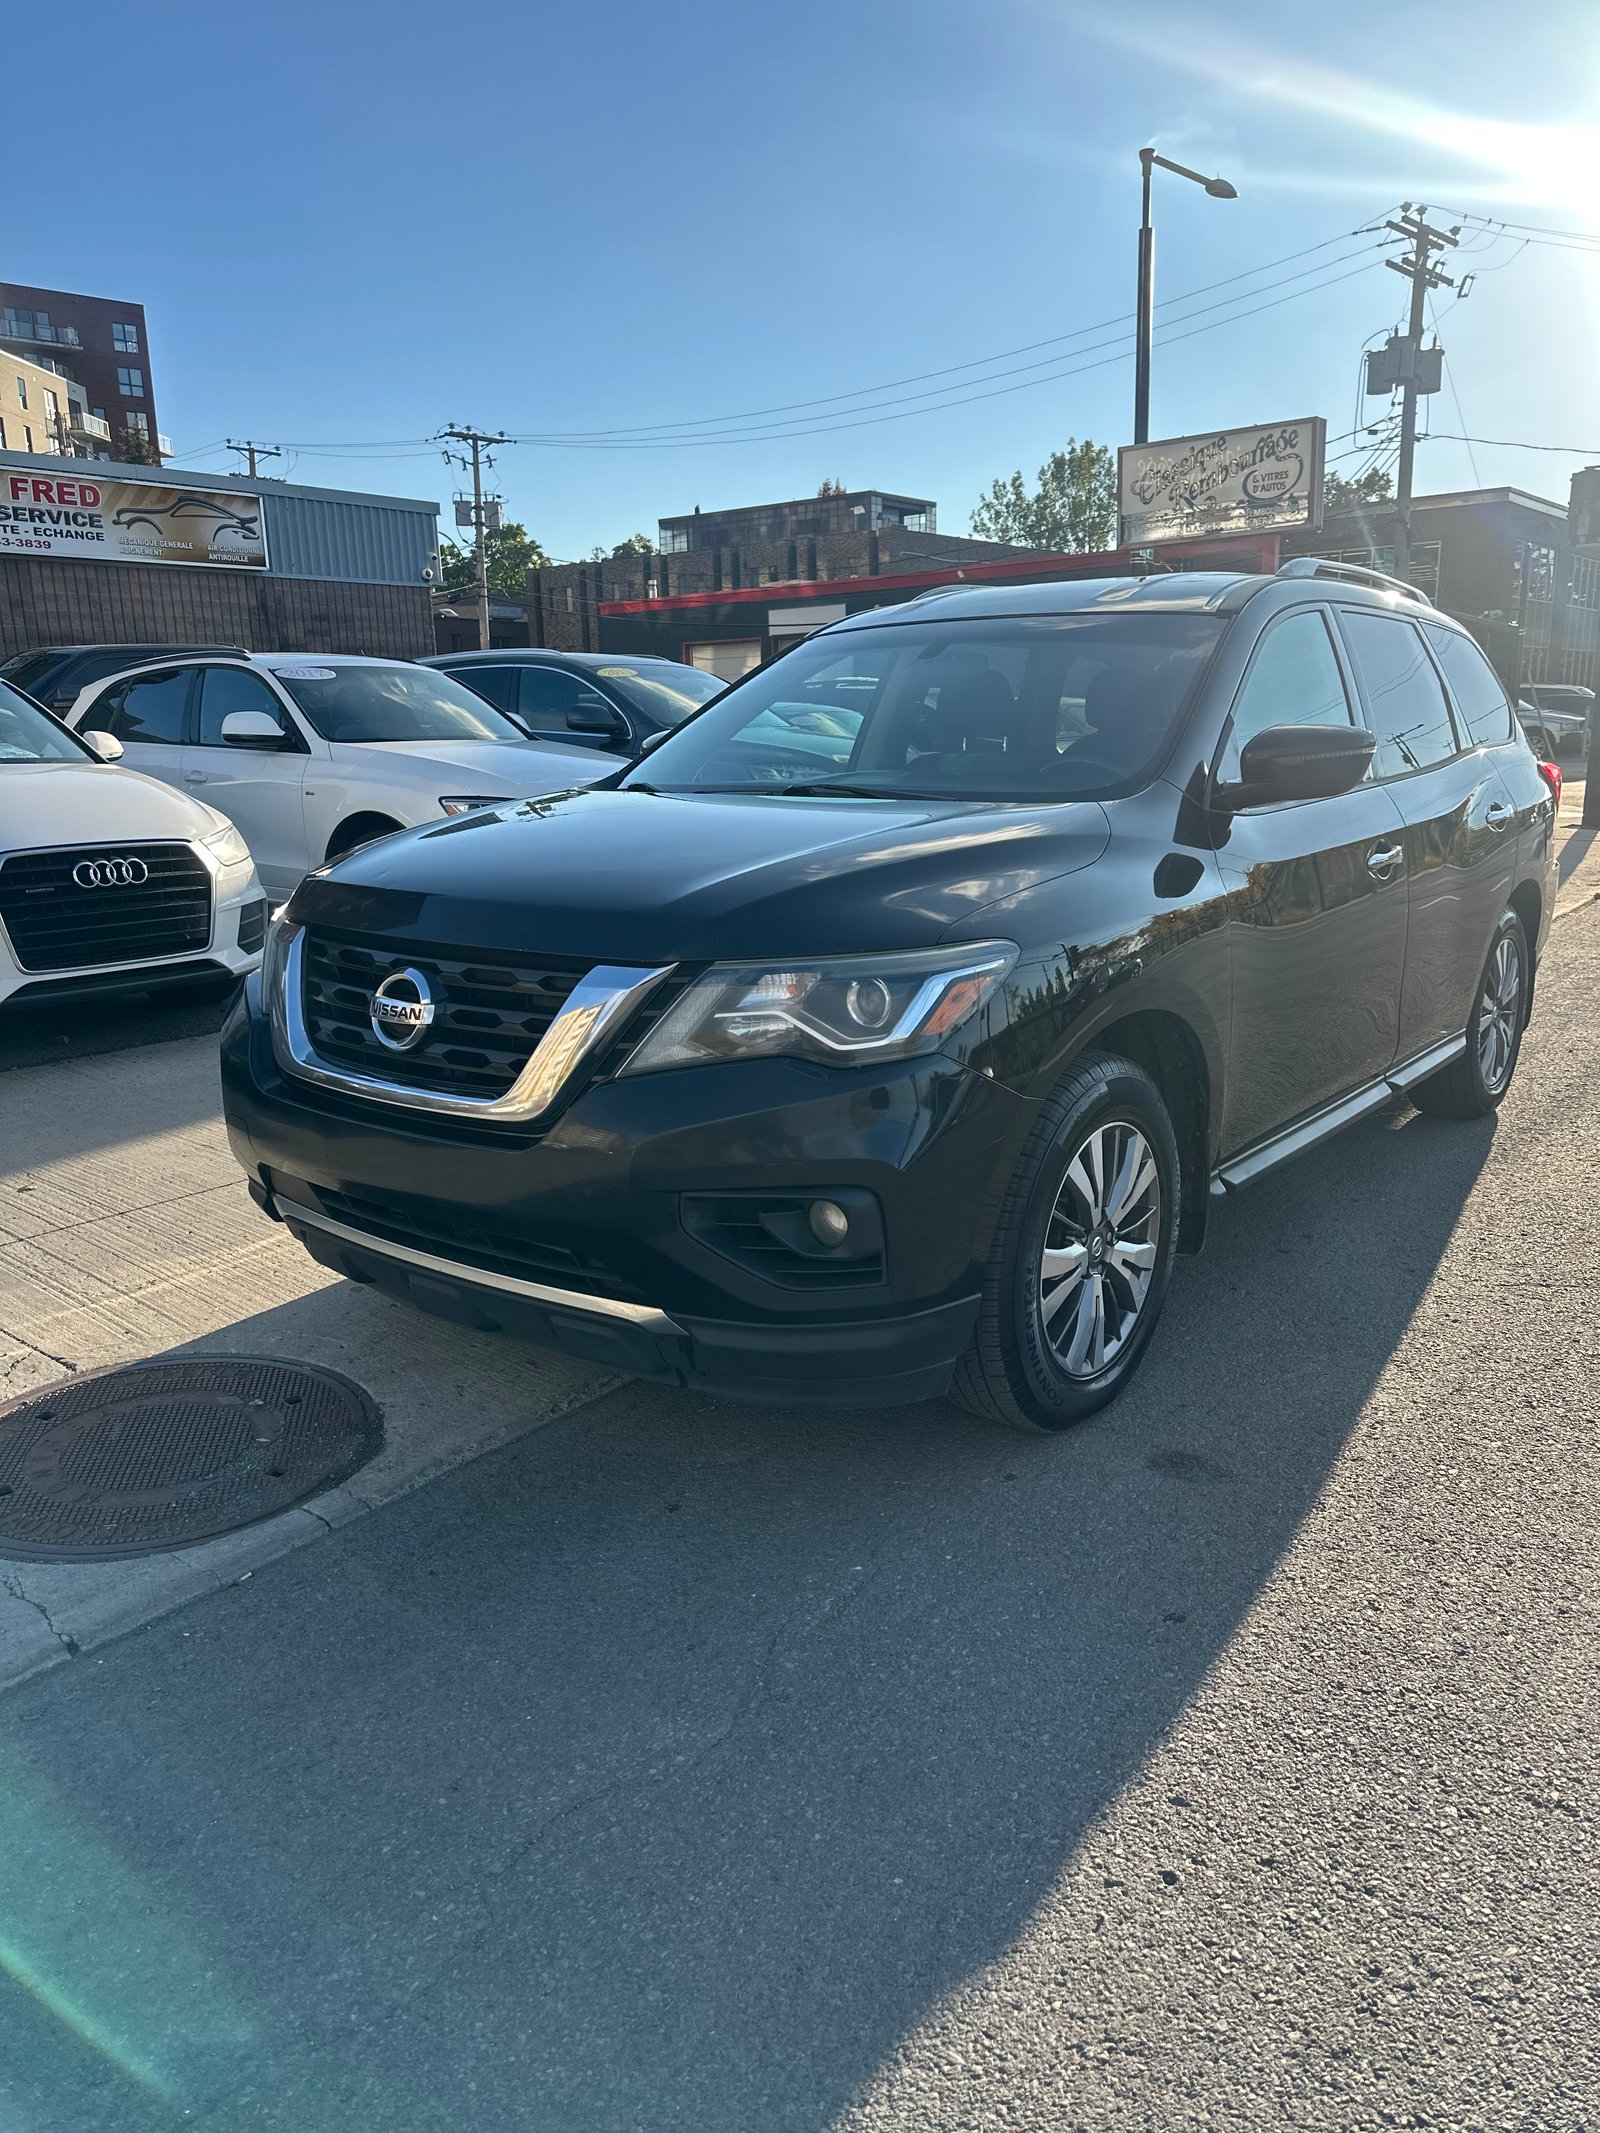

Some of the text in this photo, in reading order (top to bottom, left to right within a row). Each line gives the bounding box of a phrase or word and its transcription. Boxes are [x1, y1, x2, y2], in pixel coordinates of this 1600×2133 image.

[1252, 471, 1289, 484] & VITRES
[9, 476, 101, 508] FRED
[1253, 482, 1286, 494] D'AUTOS
[0, 504, 104, 529] SERVICE
[33, 527, 105, 541] ECHANGE
[0, 537, 51, 549] 3-3839
[208, 544, 219, 552] AIR
[208, 553, 249, 563] ANTIROUILLE
[284, 669, 324, 678] 2017
[370, 998, 422, 1021] NISSAN
[1021, 1260, 1065, 1408] CONTINENTAL
